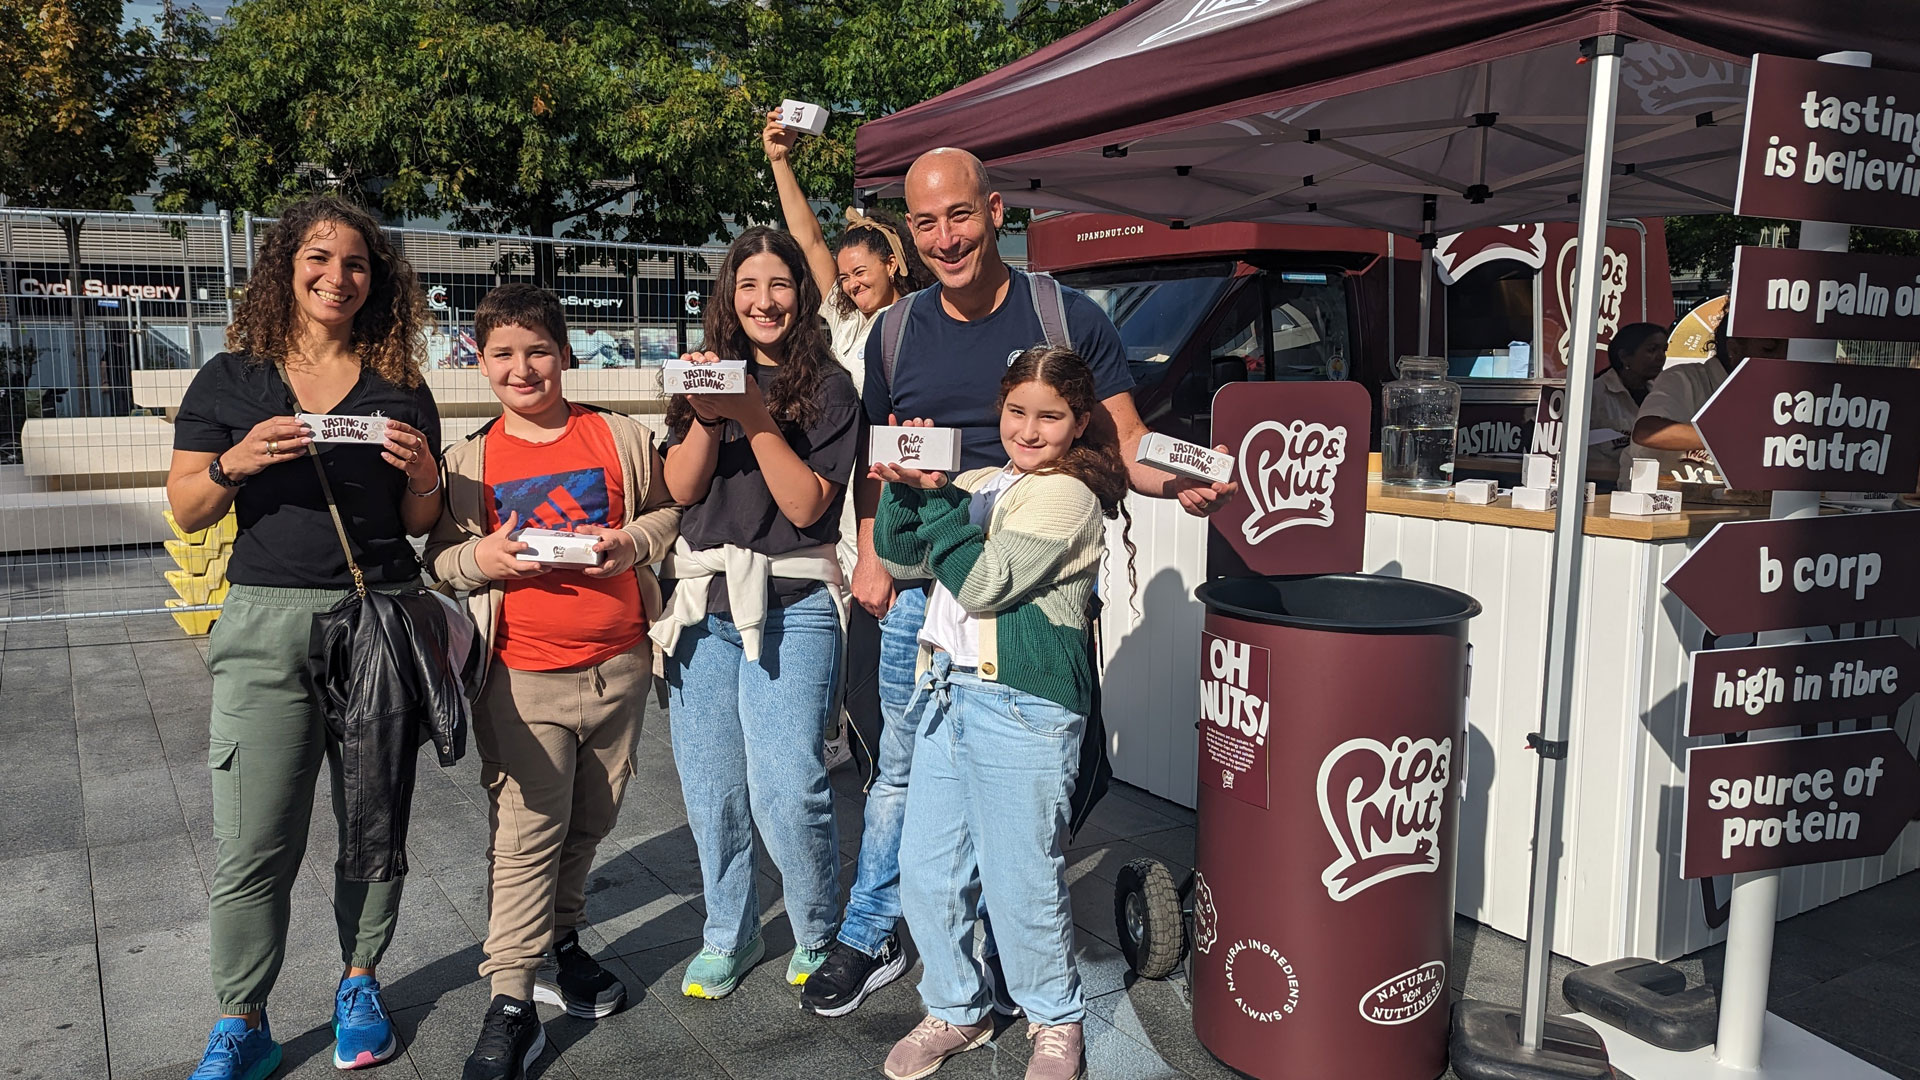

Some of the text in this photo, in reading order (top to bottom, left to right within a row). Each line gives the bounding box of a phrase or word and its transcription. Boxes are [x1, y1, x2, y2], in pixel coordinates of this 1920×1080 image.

[1764, 136, 1797, 178] is
[1076, 225, 1144, 242] PIPANDNUT.COM
[1767, 272, 1920, 324] no palm oi
[683, 369, 726, 381] TASTING IS
[683, 378, 725, 391] BELIEVING
[321, 417, 369, 431] TASTING IS
[1773, 382, 1891, 431] carbon
[321, 427, 369, 441] BELIEVING
[903, 445, 920, 455] Nut
[1173, 443, 1215, 465] TASTING IS
[1457, 421, 1521, 455] ASTING
[1763, 432, 1892, 475] neutral
[1169, 453, 1211, 475] BELIEVING
[1267, 463, 1331, 508] Nut
[1760, 546, 1882, 601] b corp
[1210, 638, 1250, 689] OH
[1713, 660, 1898, 715] high in fibre
[1200, 679, 1269, 747] NUTS!
[1708, 757, 1885, 810] source of
[1360, 789, 1438, 853] Nut
[1722, 801, 1861, 859] protein
[1225, 938, 1300, 1014] NATURAL INGREDIENTS
[1376, 968, 1437, 1003] NATURAL
[1402, 986, 1422, 1003] P&N
[1234, 997, 1282, 1023] ALWAYS
[1371, 980, 1441, 1019] NUTTINESS
